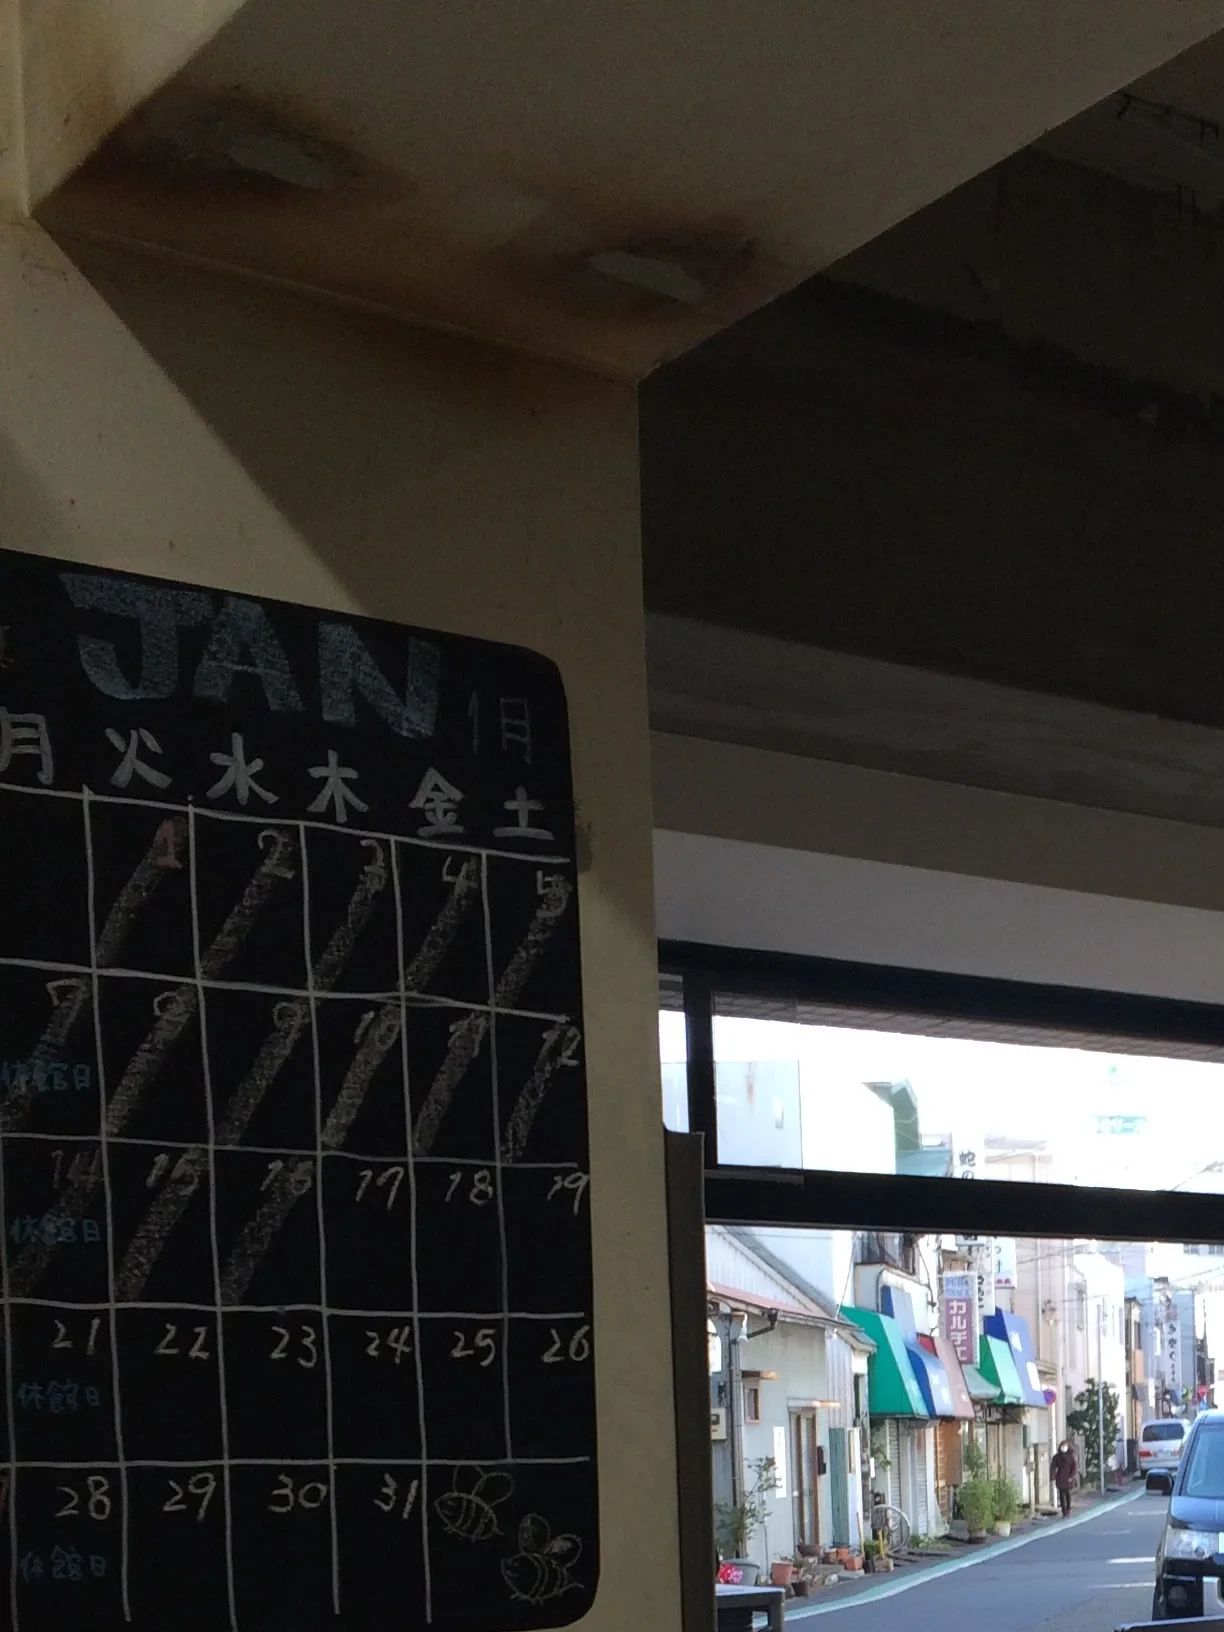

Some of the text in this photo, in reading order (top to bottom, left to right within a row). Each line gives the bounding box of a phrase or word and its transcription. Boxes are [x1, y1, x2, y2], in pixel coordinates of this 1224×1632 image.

[57, 572, 442, 740] JAN
[0, 705, 555, 841] 月 火 水 木 金 土
[256, 827, 296, 880] 2
[441, 854, 478, 892] 4
[355, 1166, 405, 1210] 17
[445, 1170, 494, 1206] 18
[546, 1170, 590, 1215] 19
[53, 1318, 591, 1369] 21 22 23 24 25 26
[55, 1471, 419, 1521] 28 29 30 31
